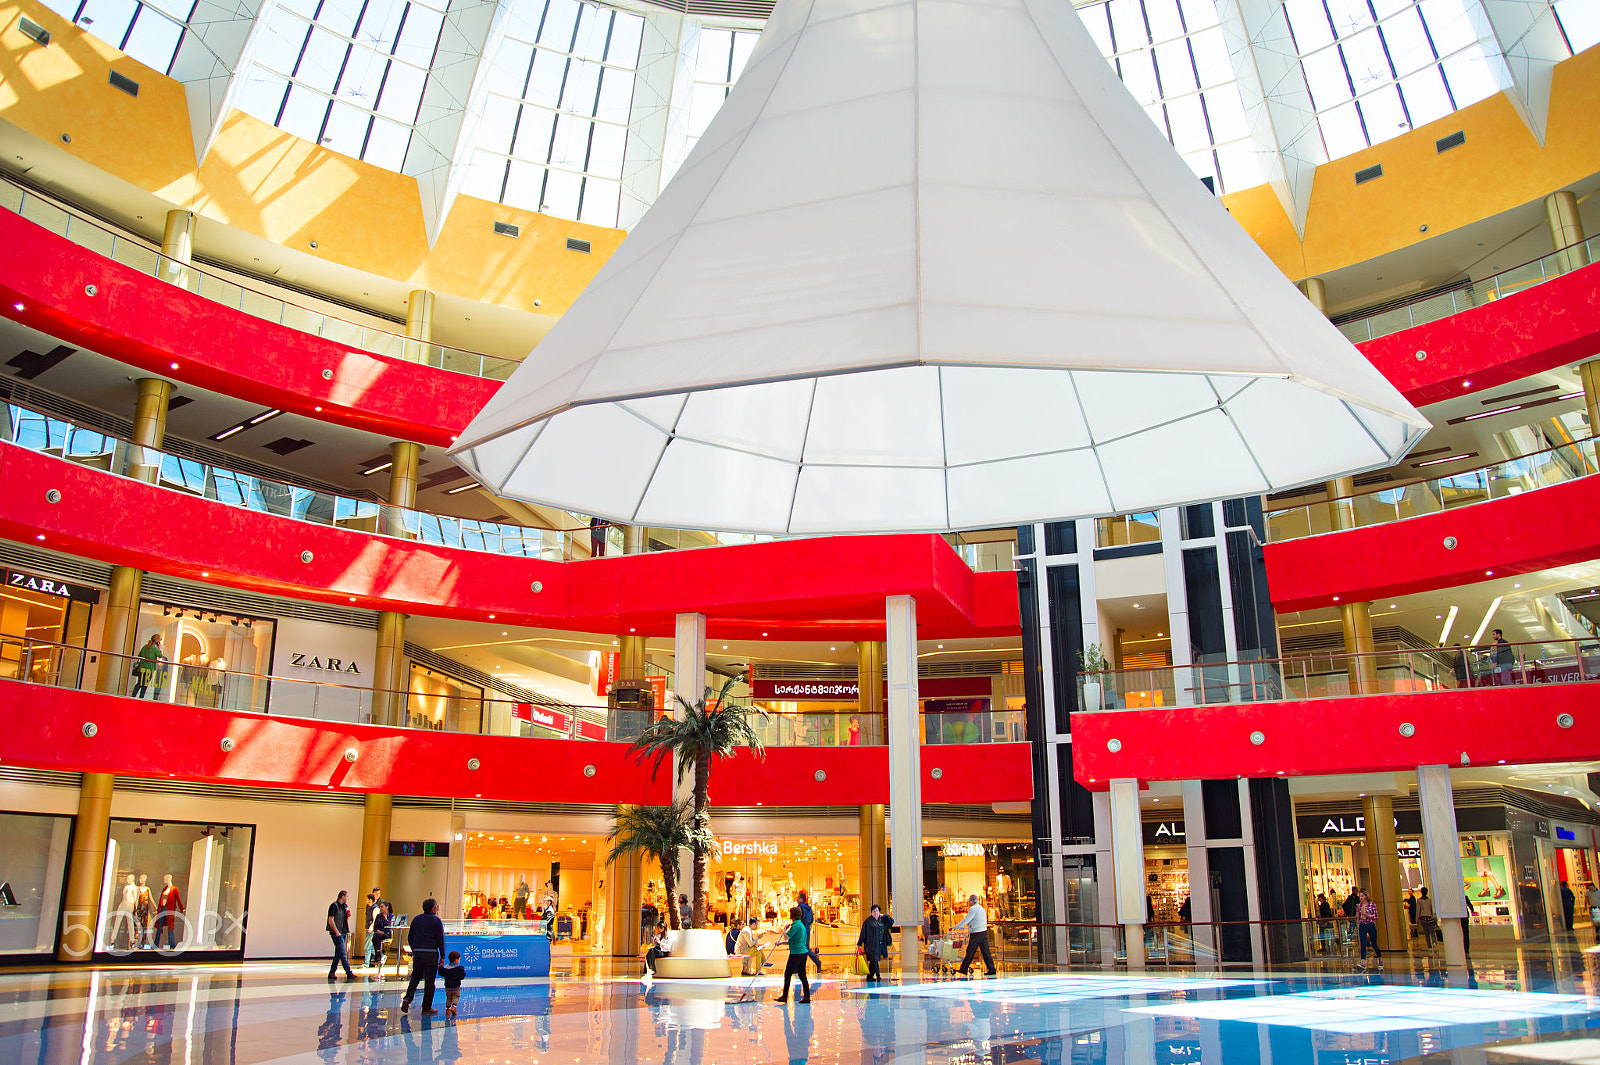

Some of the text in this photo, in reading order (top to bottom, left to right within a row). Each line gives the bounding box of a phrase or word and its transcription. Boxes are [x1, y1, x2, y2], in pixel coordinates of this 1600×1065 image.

[10, 573, 71, 597] ZARA
[289, 652, 361, 675] ZARA
[140, 667, 214, 696] TBILISI MALL
[1547, 672, 1580, 683] SILVER
[723, 840, 778, 855] Bershka
